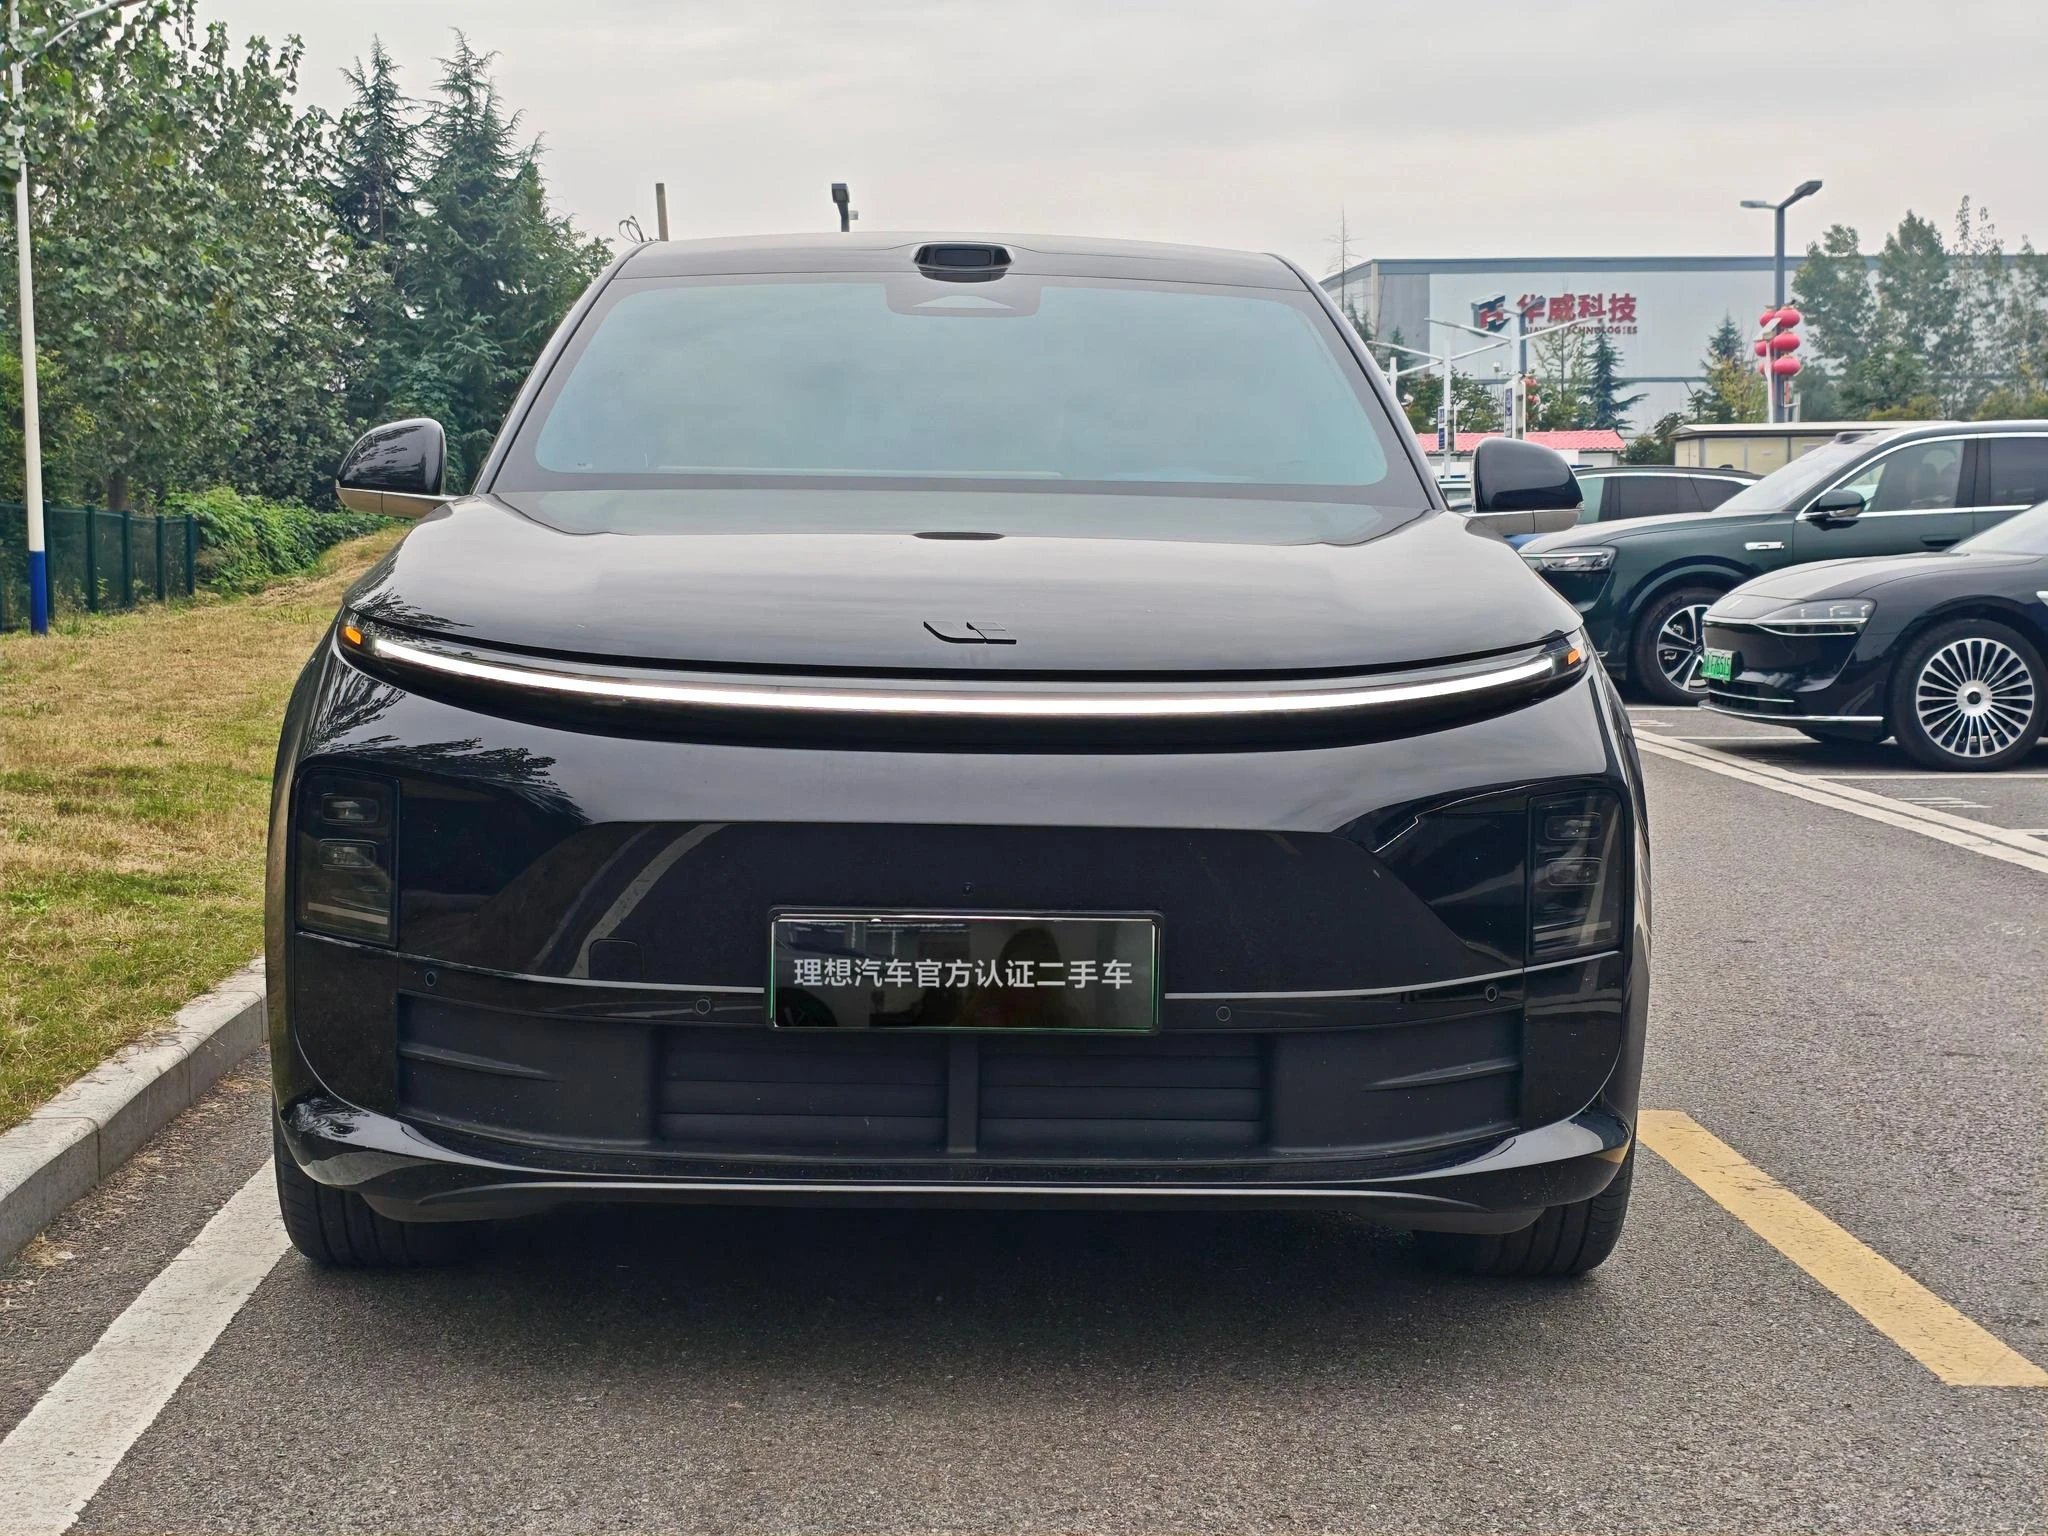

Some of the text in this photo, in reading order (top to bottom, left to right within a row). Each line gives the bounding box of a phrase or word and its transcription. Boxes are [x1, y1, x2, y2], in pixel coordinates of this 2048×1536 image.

[1516, 293, 1637, 323] 华威科技
[794, 958, 1133, 990] 理想汽车官方认证二手车
